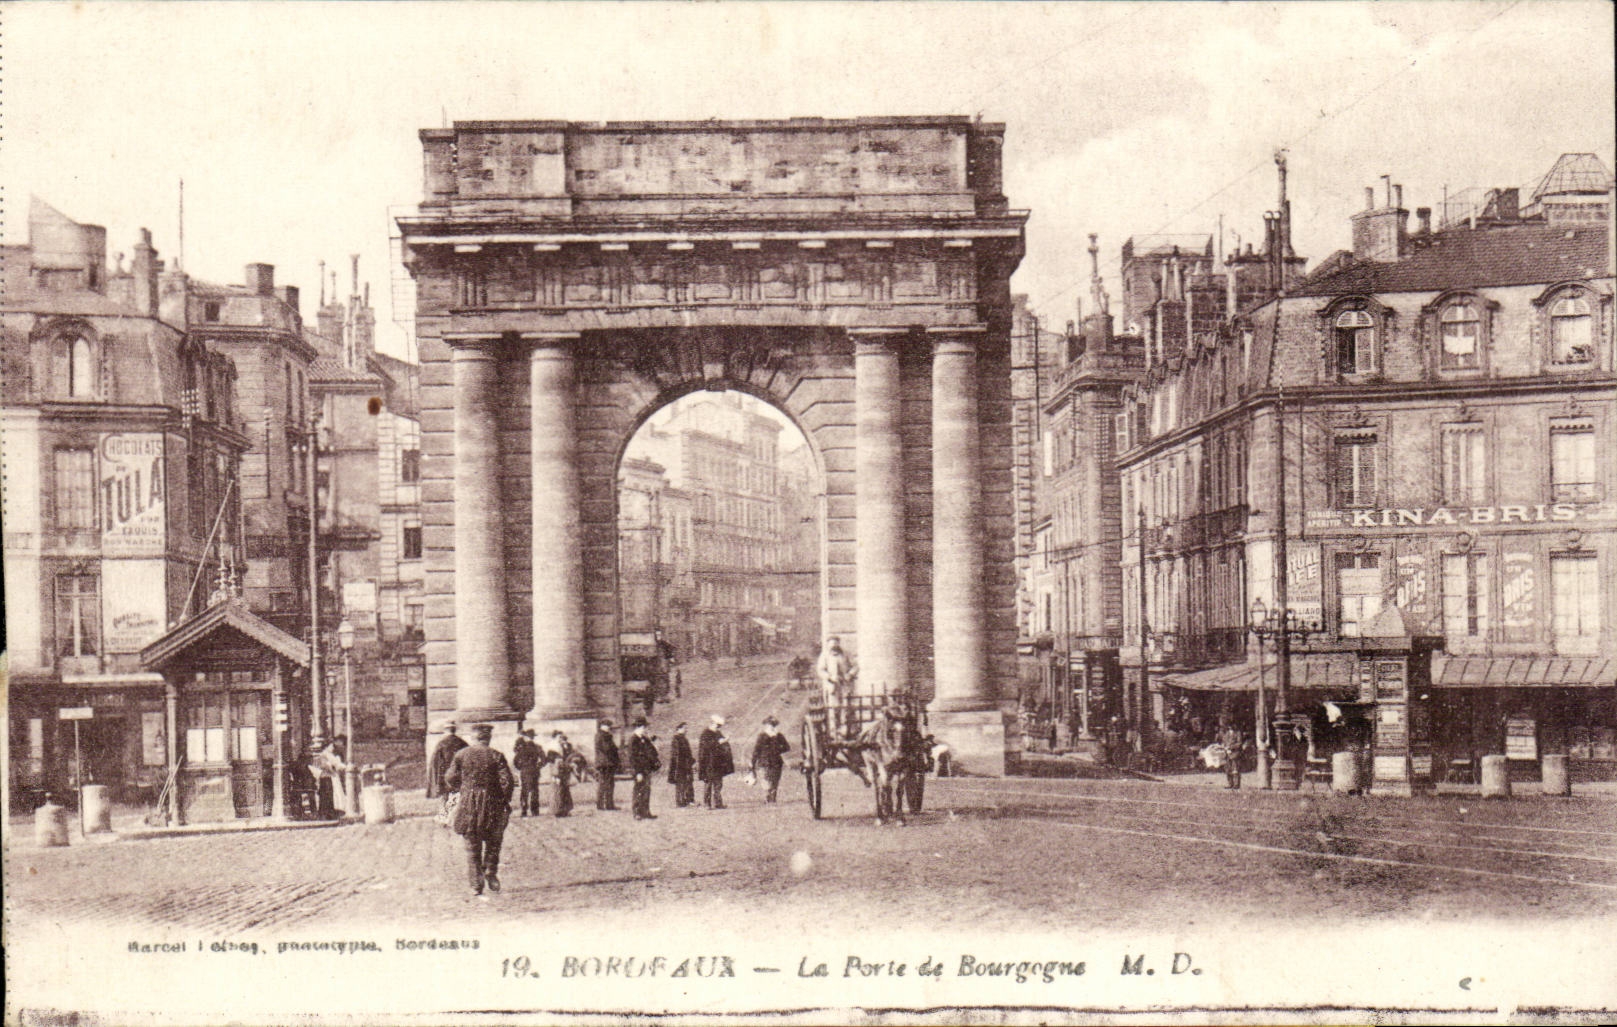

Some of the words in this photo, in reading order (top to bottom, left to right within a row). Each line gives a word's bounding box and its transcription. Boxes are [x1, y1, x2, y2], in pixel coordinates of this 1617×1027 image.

[102, 433, 163, 463] CHOCOLATS
[101, 456, 164, 532] TULA
[1351, 503, 1577, 528] KINA-BRIS
